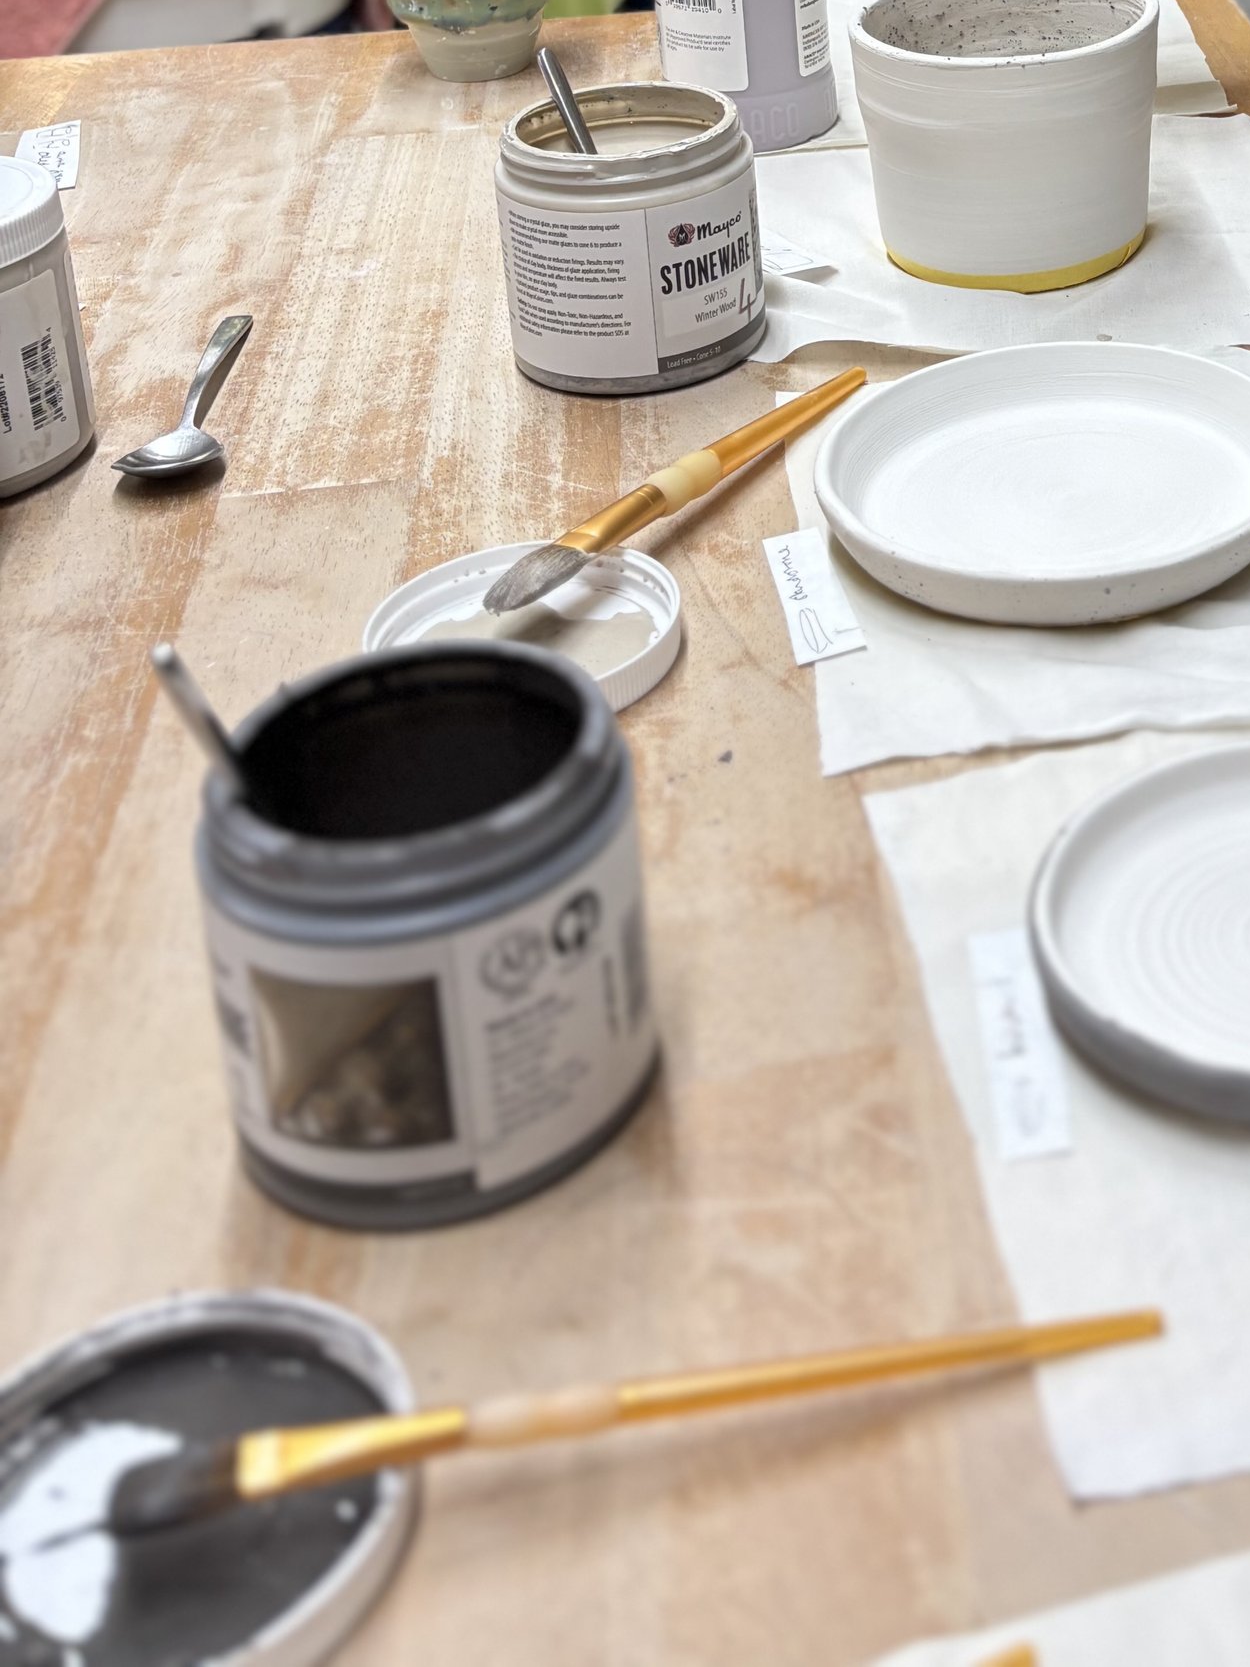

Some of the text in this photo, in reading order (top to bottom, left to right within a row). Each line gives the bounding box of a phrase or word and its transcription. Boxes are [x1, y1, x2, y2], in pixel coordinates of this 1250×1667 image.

[697, 214, 741, 240] Mayco
[660, 231, 751, 295] STONEWARE
[704, 287, 728, 306] SW155
[695, 298, 737, 324] Winter Wood
[667, 356, 680, 369] Lead
[681, 356, 693, 366] Free
[696, 350, 709, 362] Cone
